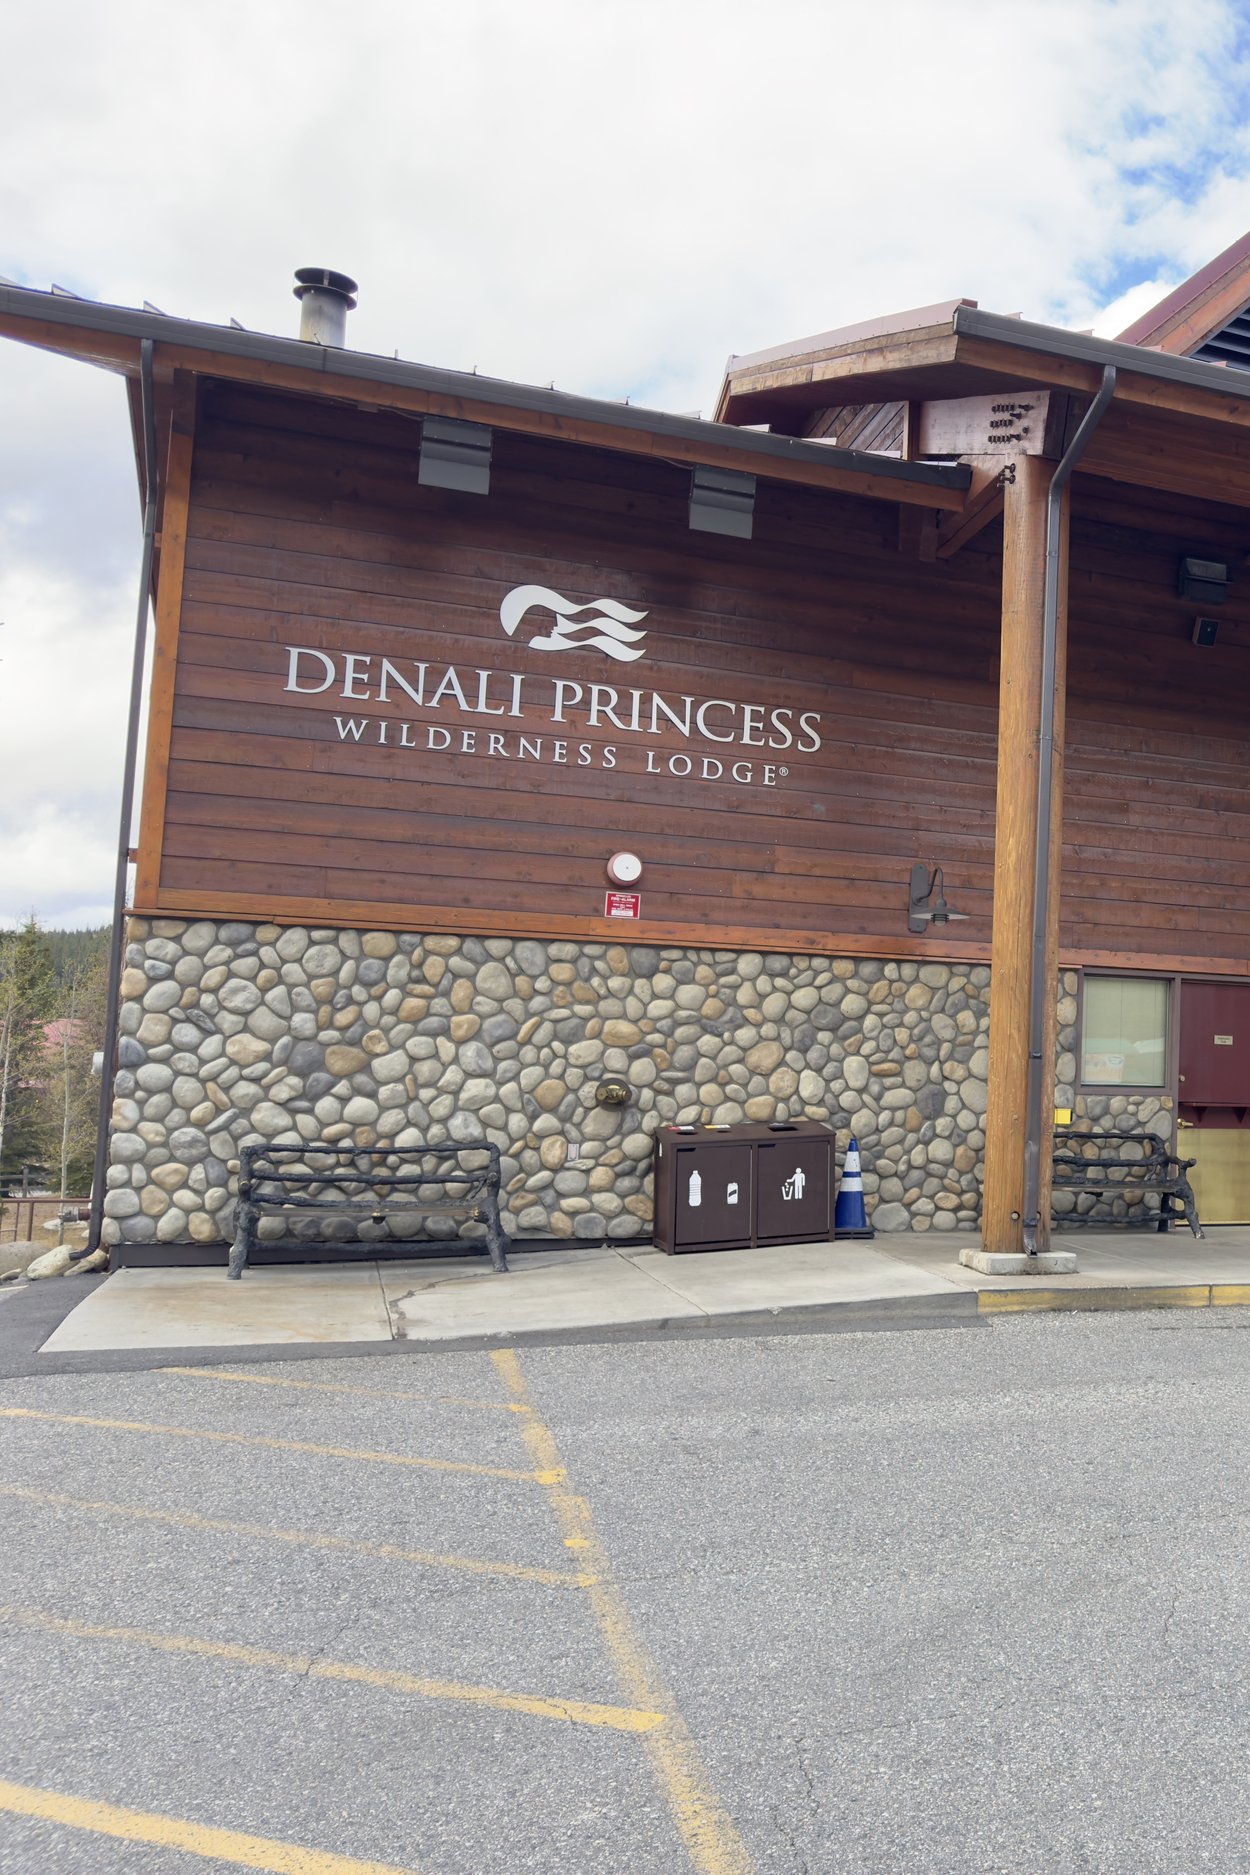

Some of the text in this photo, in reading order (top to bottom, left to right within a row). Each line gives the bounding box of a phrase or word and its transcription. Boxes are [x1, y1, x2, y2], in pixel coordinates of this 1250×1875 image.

[284, 647, 822, 753] DENALI PRINCESS
[333, 716, 617, 768] WILDERNESS
